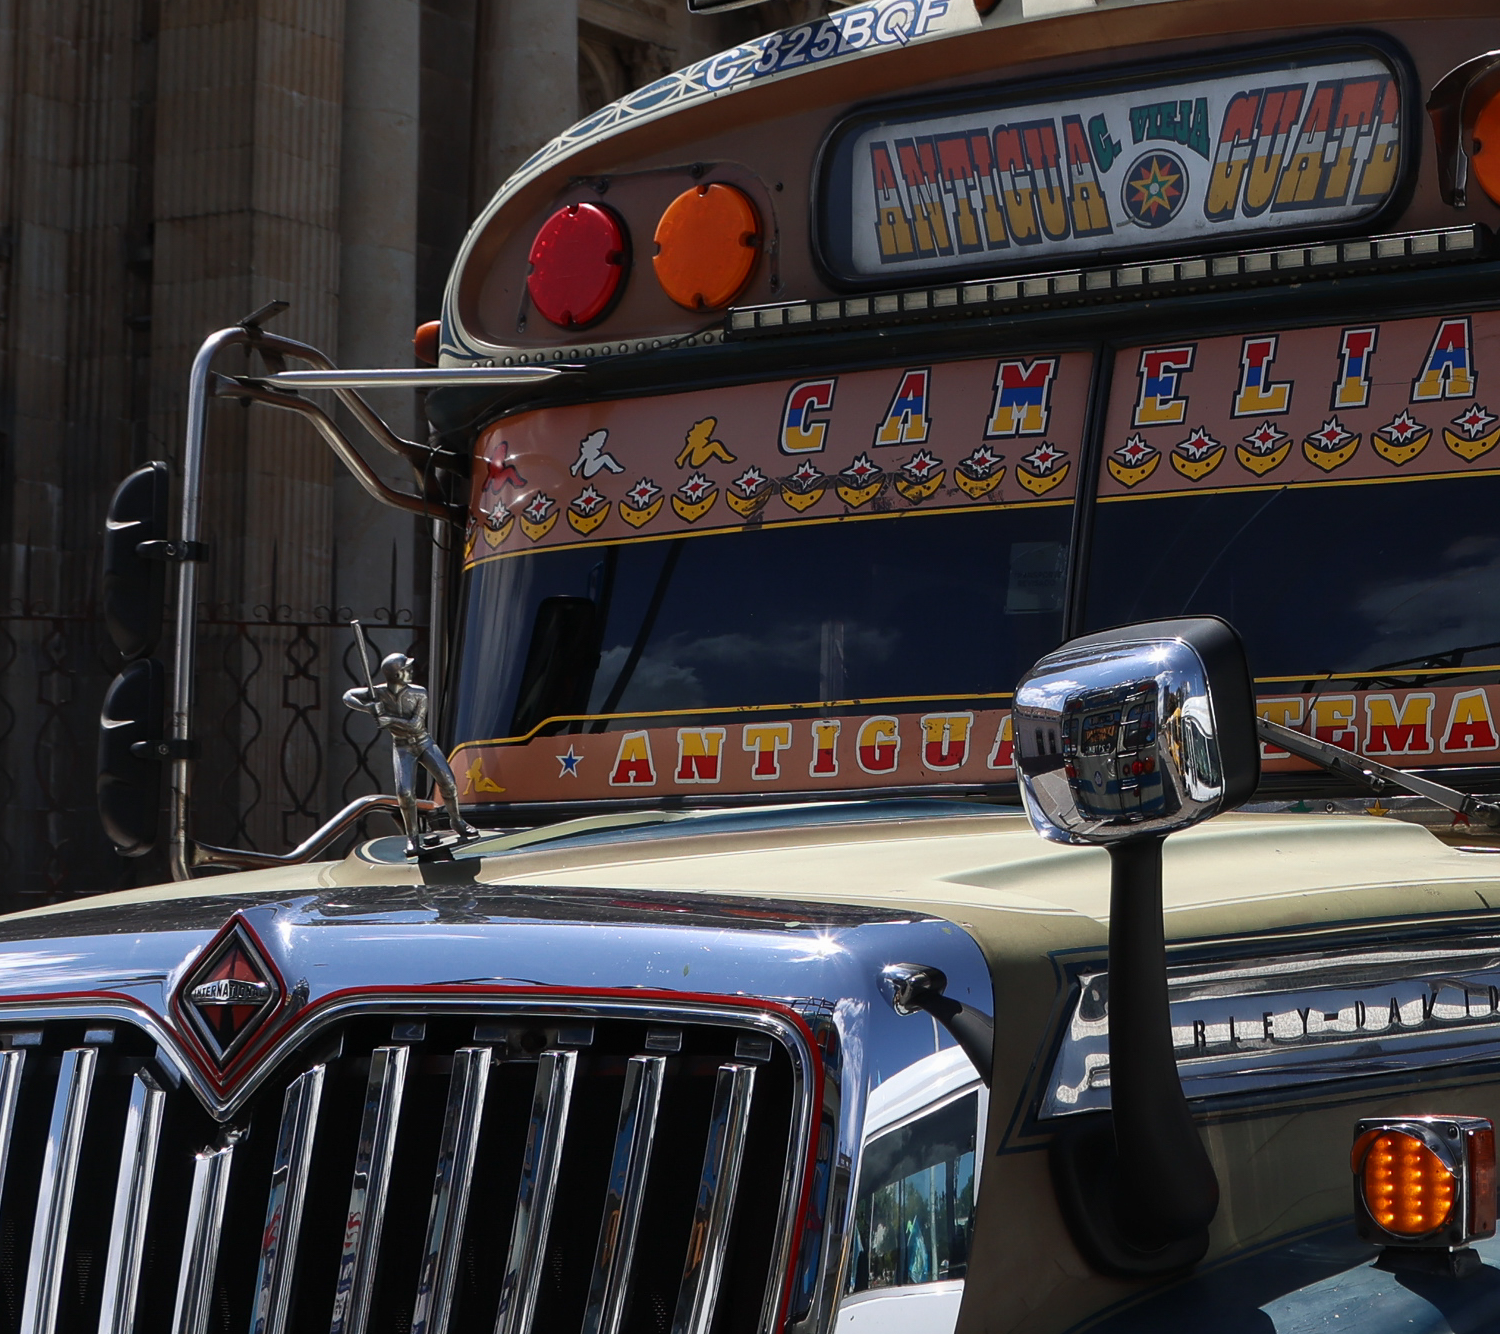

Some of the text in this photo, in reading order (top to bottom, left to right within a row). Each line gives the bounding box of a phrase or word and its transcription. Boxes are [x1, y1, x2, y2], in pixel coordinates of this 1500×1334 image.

[704, 49, 742, 92] C
[1128, 96, 1211, 161] VIEJA
[868, 113, 1114, 265] ANTIGUA
[778, 315, 1479, 456] CAMELIA
[193, 982, 265, 998] INTERNATIONAL
